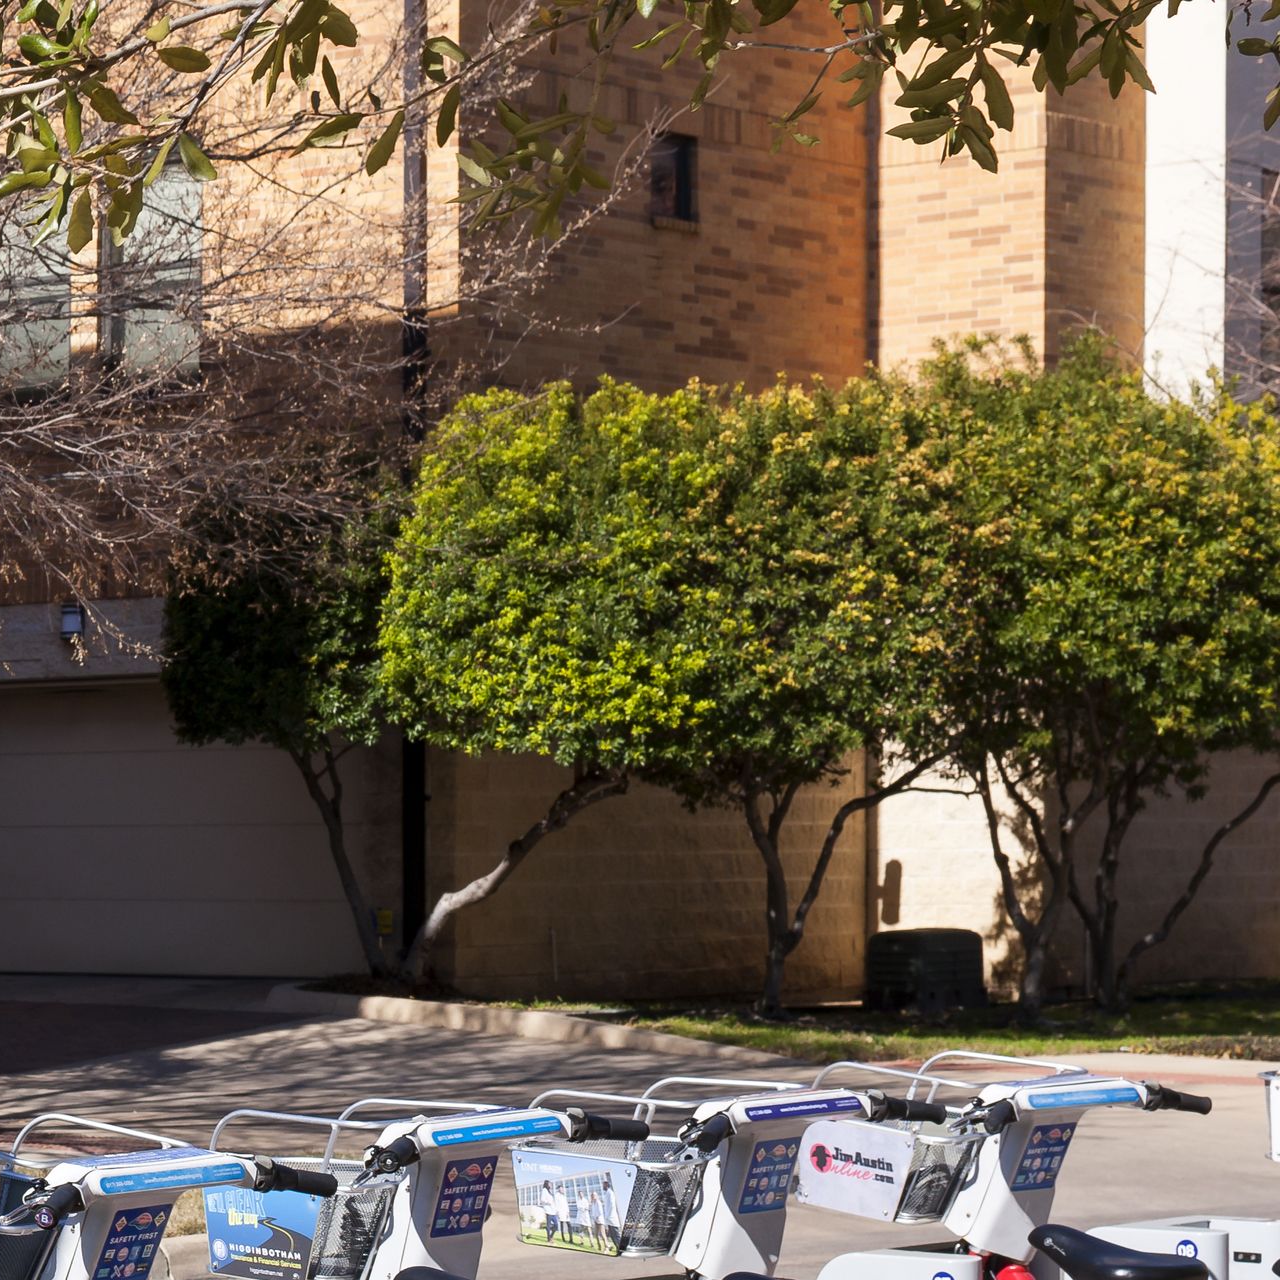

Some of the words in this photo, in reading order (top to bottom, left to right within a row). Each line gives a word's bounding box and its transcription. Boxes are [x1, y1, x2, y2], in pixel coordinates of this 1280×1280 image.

[752, 1166, 774, 1174] SAFETY
[775, 1162, 792, 1170] FIRST
[444, 1185, 468, 1195] SAFETY
[469, 1183, 488, 1192] FIRST
[225, 1189, 267, 1217] CLEAR
[109, 1235, 136, 1244] SAFETY
[137, 1232, 158, 1241] FIRST
[229, 1243, 301, 1260] HIGGINBOTHAM
[1177, 1244, 1195, 1258] 08
